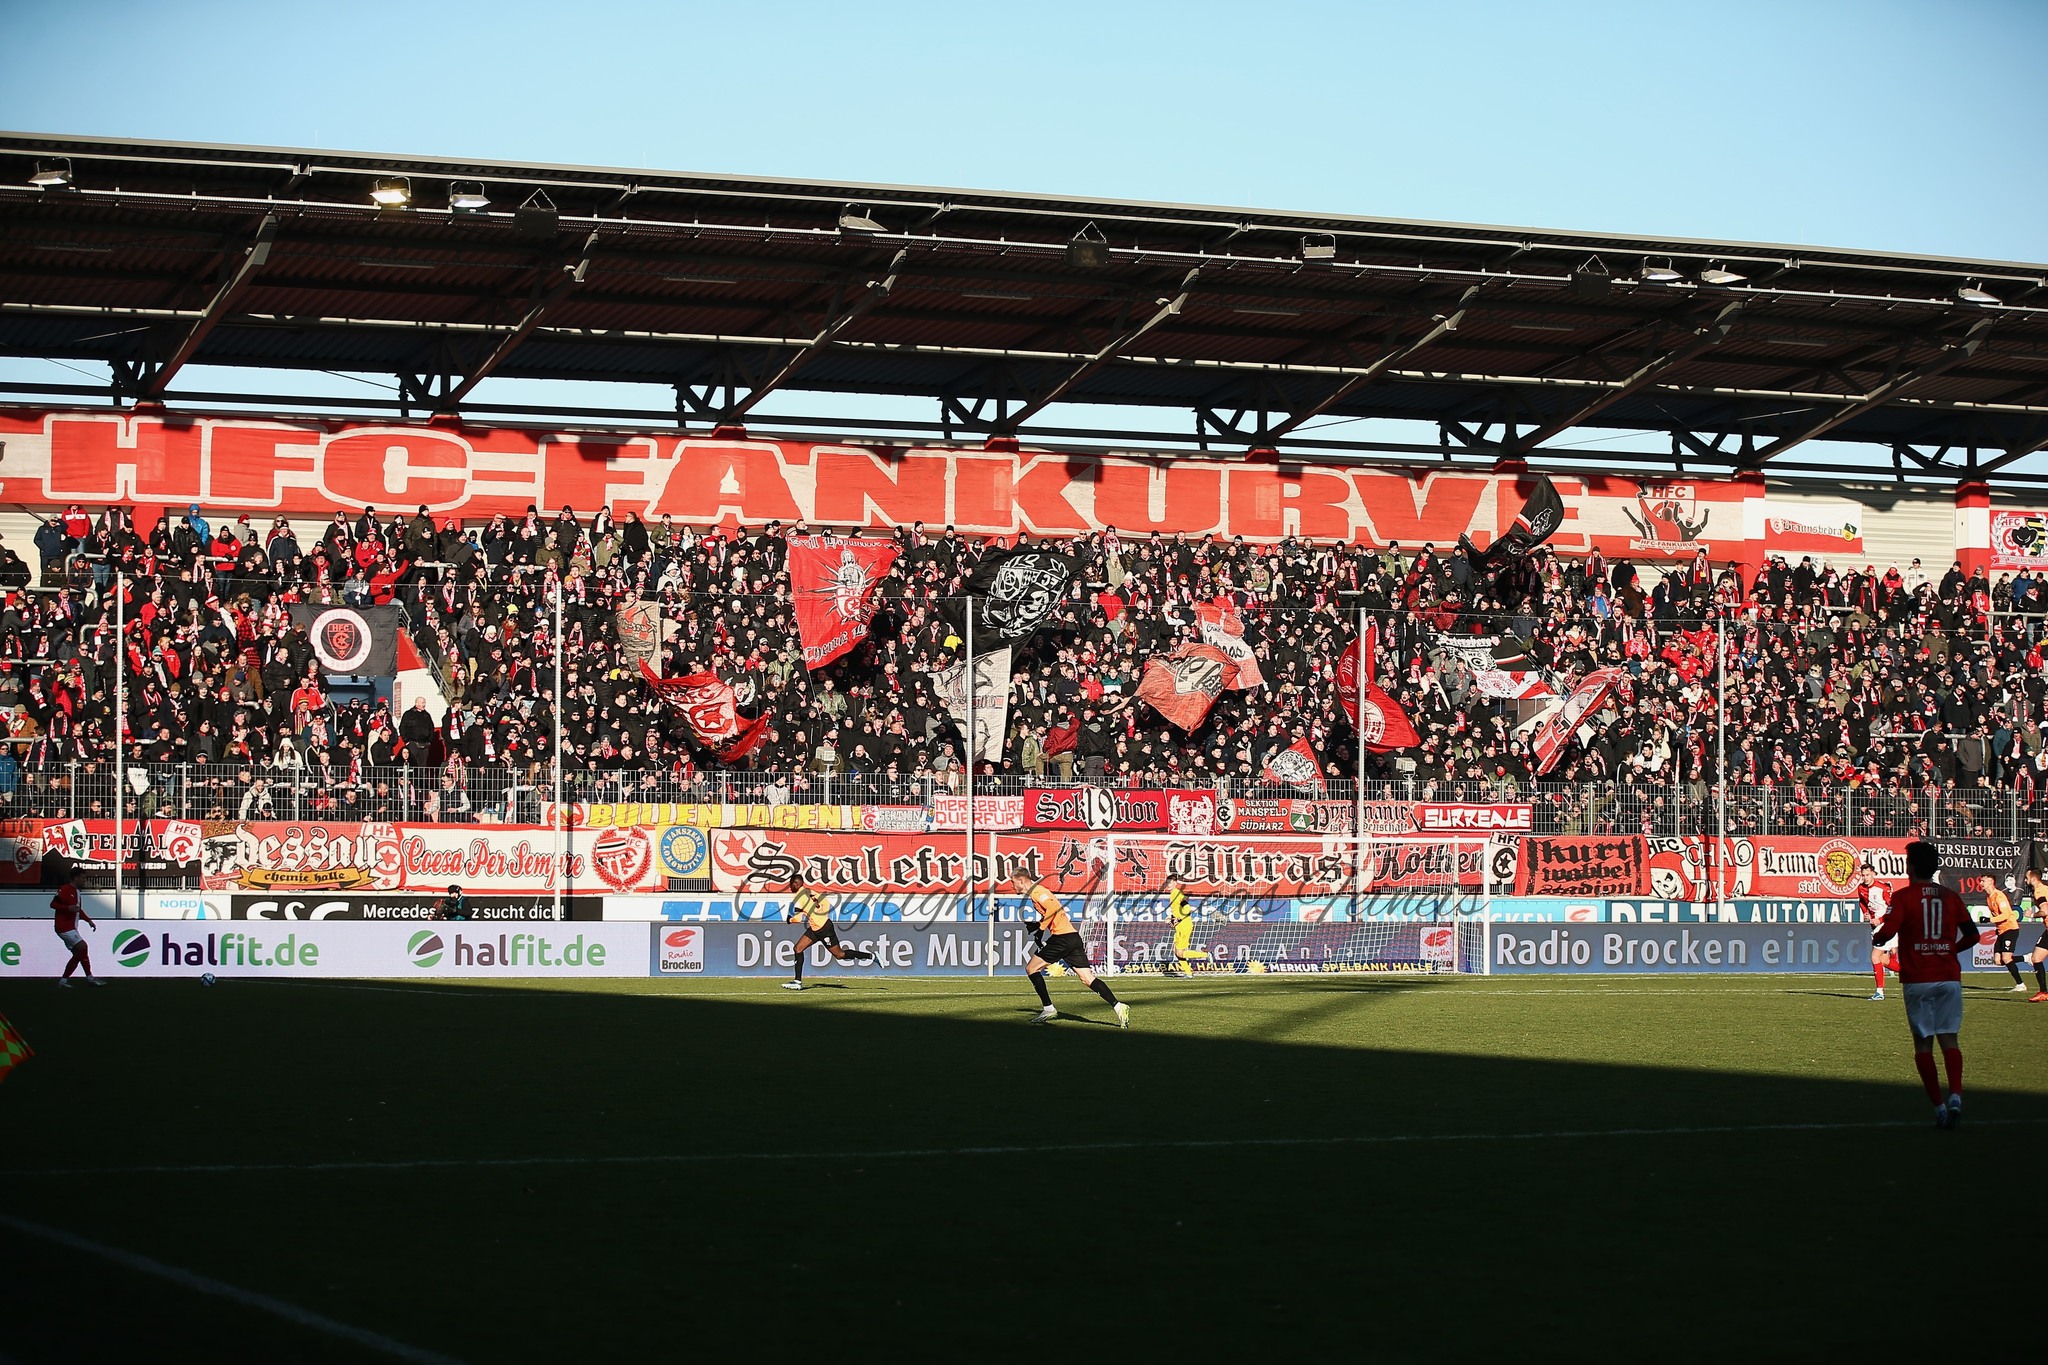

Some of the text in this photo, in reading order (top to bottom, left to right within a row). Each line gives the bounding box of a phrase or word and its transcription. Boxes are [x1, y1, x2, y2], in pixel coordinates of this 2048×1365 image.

[43, 412, 1592, 553] HFC-FANKURVE
[1651, 486, 1687, 498] HFC
[1640, 540, 1698, 548] HFC-FANKURVE
[1246, 799, 1279, 807] SEKTION
[587, 803, 722, 827] BULLEN
[1238, 807, 1288, 817] MANSFELD
[1424, 807, 1531, 829] SURREALE
[174, 823, 198, 836] HFC
[372, 825, 394, 837] HF
[1240, 819, 1284, 831] SÜDHARZ
[1347, 820, 1408, 833] Ledenschaft
[19, 837, 37, 848] HFC
[1649, 838, 1680, 856] HFC
[1820, 839, 1858, 859] HALLESCHER
[466, 837, 507, 878] Per
[1759, 846, 1818, 875] Leuna
[1861, 846, 1910, 877] Löw
[159, 900, 198, 908] NORD
[483, 904, 525, 919] sucht
[1920, 898, 1944, 940] 10
[161, 932, 319, 966] halfit.de
[455, 933, 606, 967] halfit.de
[668, 950, 695, 960] Radio
[736, 930, 797, 968] Die
[926, 930, 1034, 968] Musik
[1496, 930, 1590, 966] Radio
[1603, 930, 1755, 966] Brocken
[661, 960, 702, 970] Brocken
[1269, 963, 1319, 973] MERKUR
[1321, 962, 1389, 973] SPIELBANK
[1392, 962, 1433, 972] HALLE
